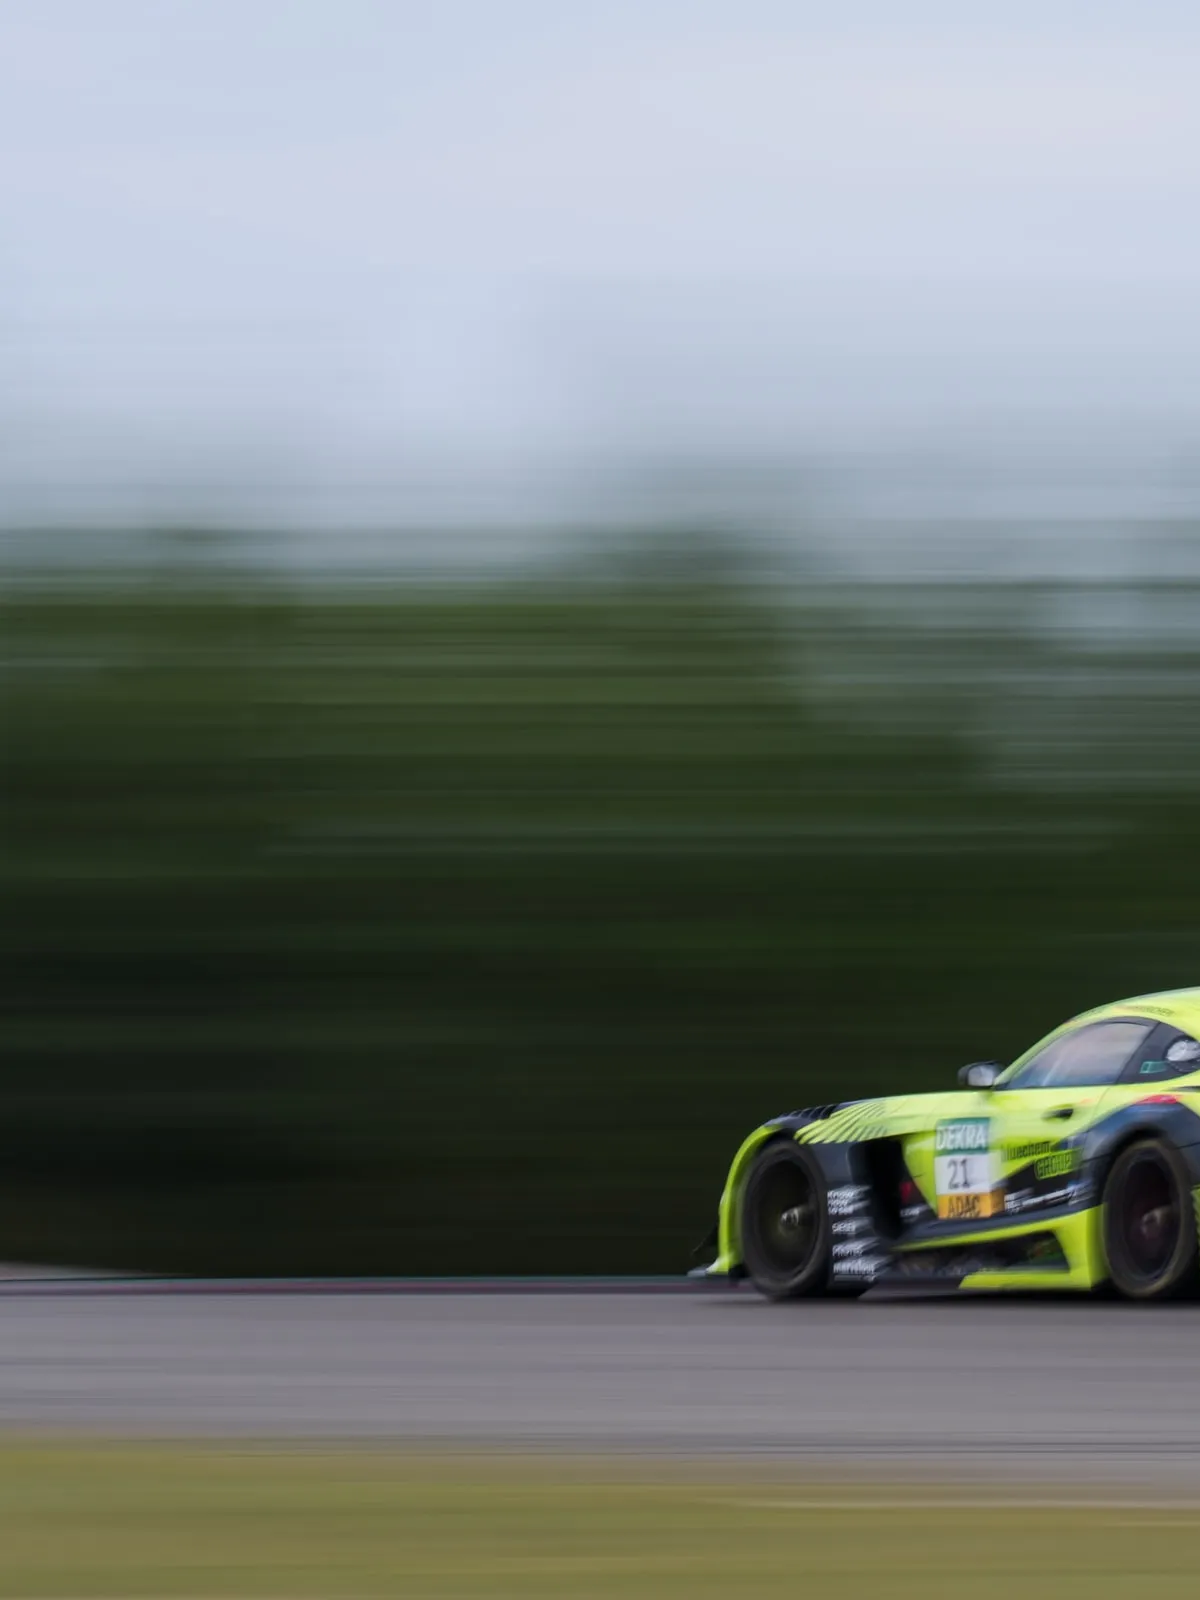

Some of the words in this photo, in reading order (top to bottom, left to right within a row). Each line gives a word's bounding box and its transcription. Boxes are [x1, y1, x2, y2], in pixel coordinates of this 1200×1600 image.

[936, 1124, 987, 1150] DEKRA
[947, 1158, 970, 1190] 21
[948, 1194, 980, 1218] ADAC
